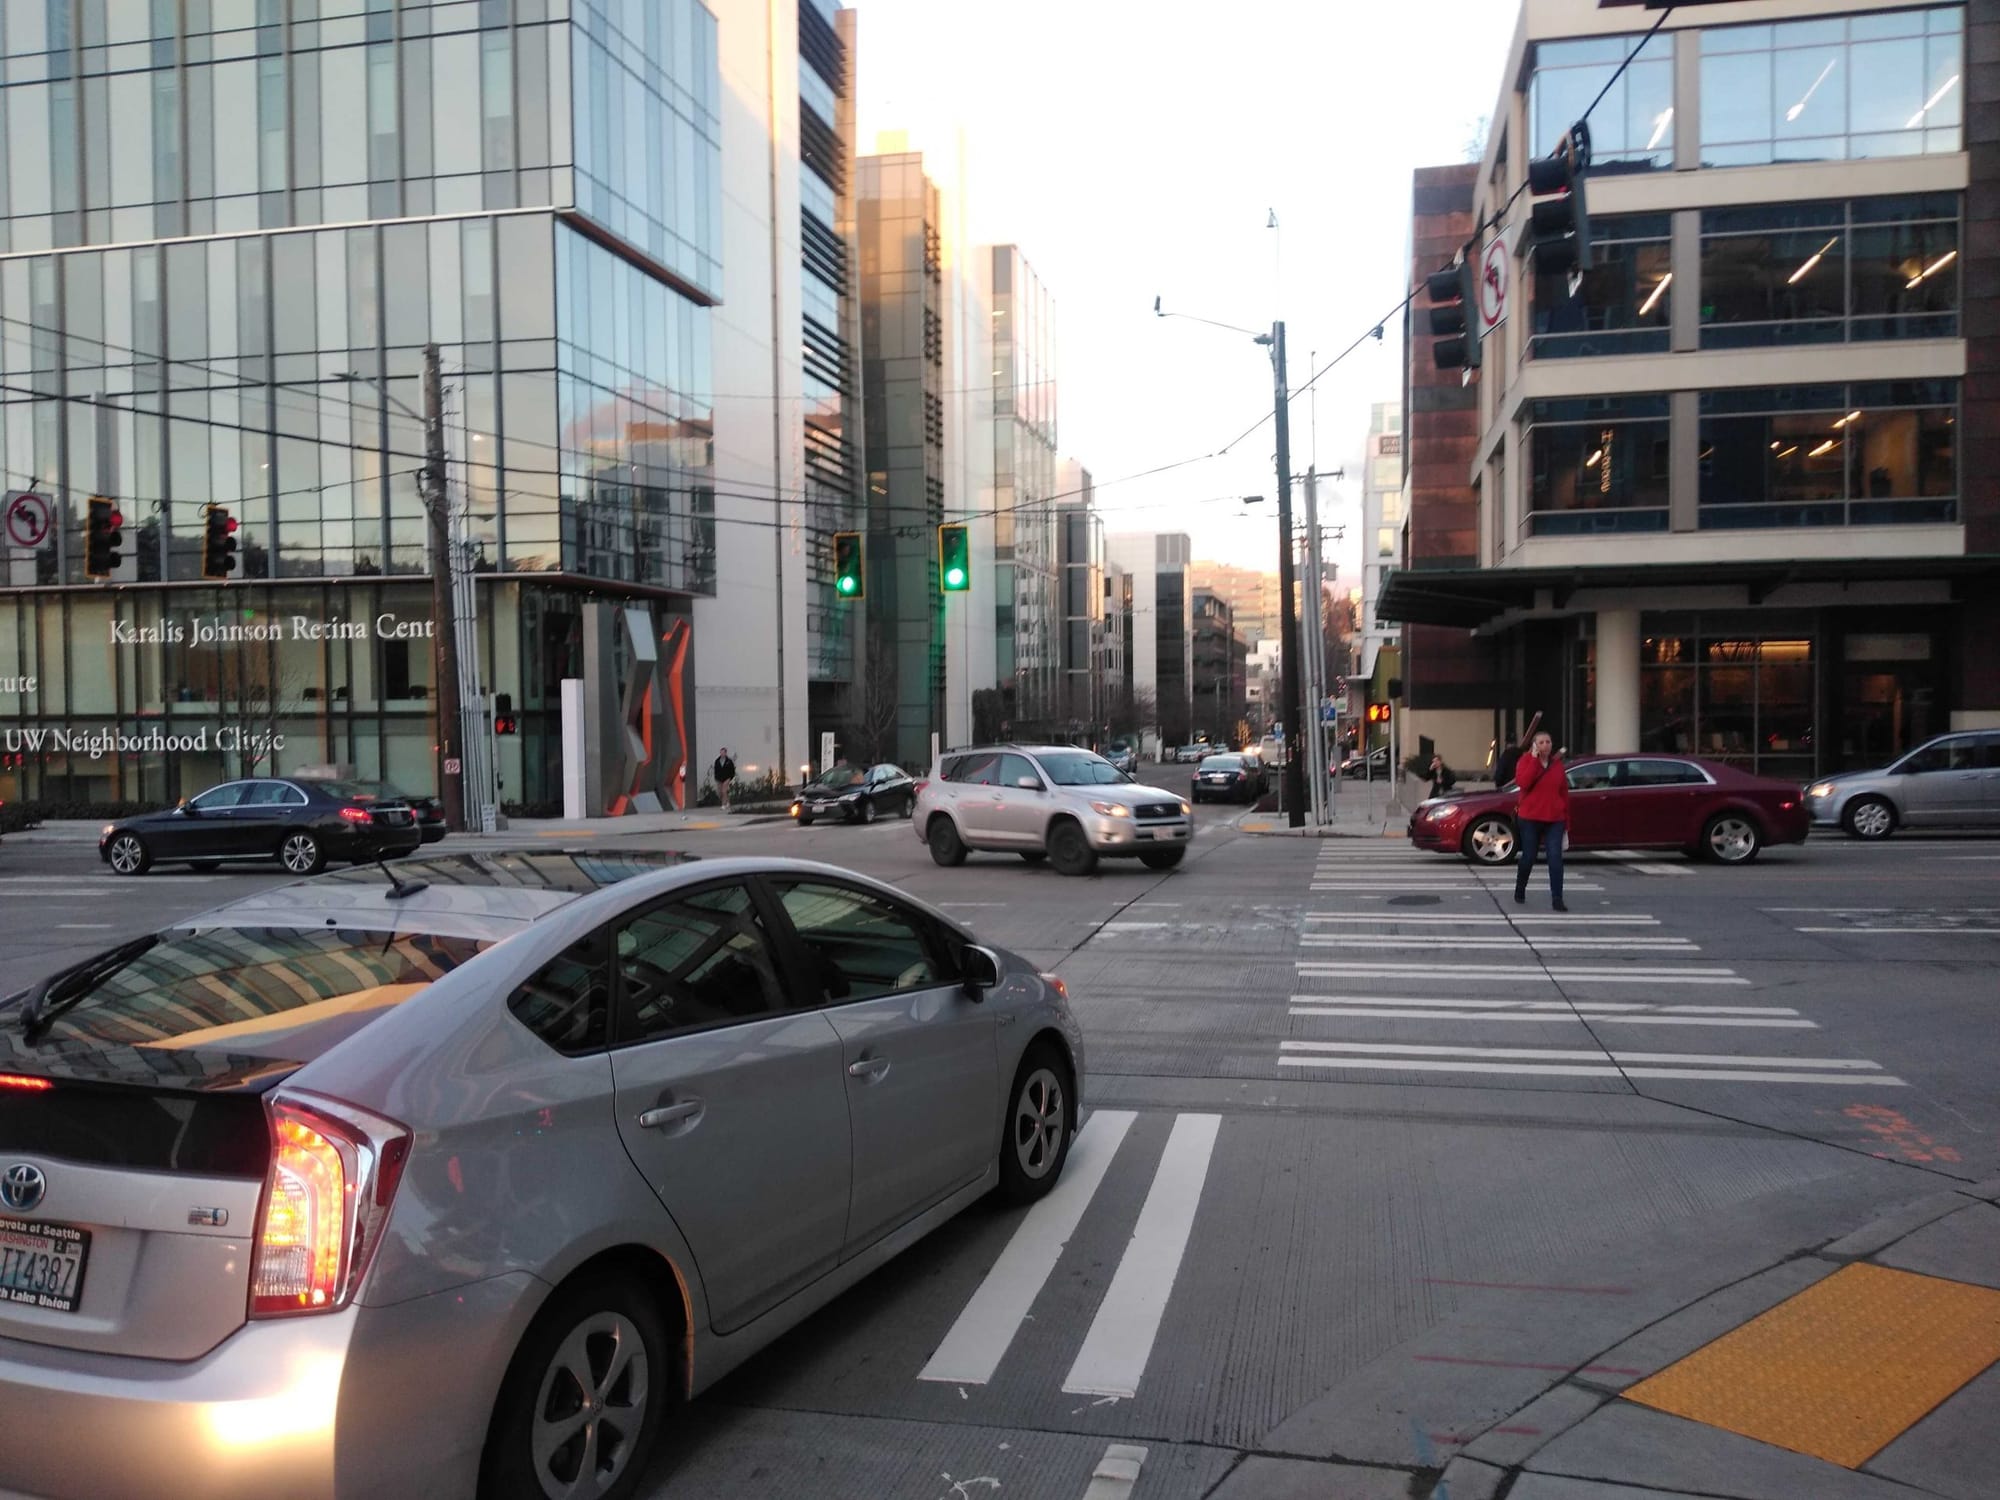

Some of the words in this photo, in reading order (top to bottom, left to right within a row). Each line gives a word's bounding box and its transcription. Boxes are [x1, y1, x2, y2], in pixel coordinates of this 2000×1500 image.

[109, 617, 185, 644] Karalis
[189, 616, 283, 649] Johnson
[291, 615, 368, 641] Retina
[4, 727, 48, 752] UW
[51, 726, 209, 760] Neighborhood
[214, 725, 286, 752] Clinic
[29, 1223, 42, 1234] of
[42, 1225, 81, 1241] Seattle
[10, 1288, 37, 1304] Lake
[38, 1294, 71, 1311] Union
